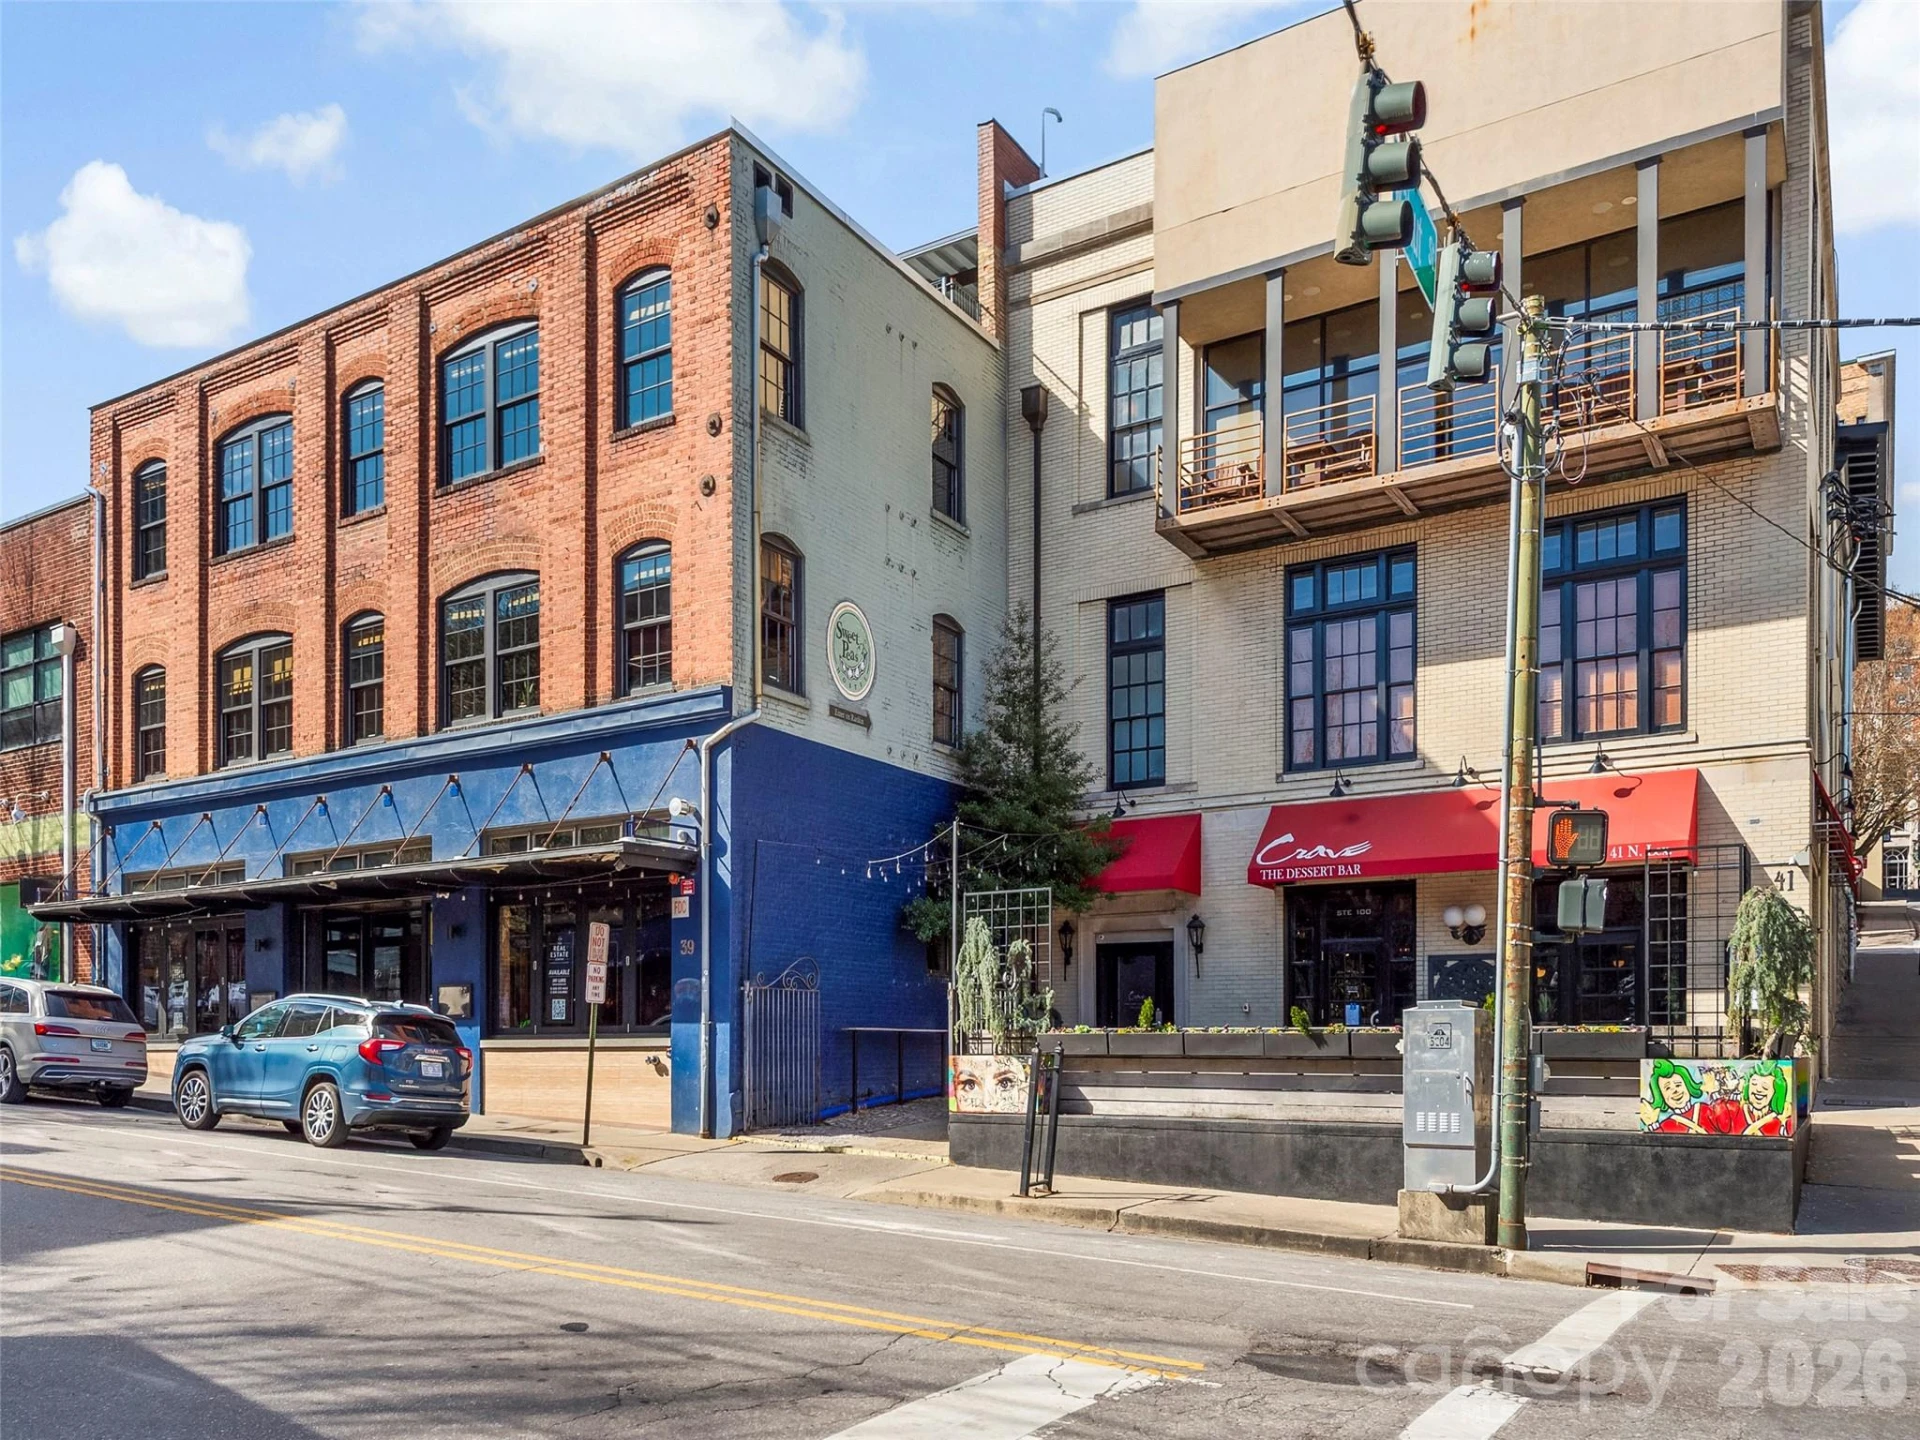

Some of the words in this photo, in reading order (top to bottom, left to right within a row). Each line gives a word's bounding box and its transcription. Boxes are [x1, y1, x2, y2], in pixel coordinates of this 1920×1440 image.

[836, 621, 860, 645] Sweet
[842, 640, 859, 662] Peas
[1256, 833, 1372, 865] Crave
[1609, 845, 1623, 859] 41
[1627, 845, 1642, 858] N.
[1260, 869, 1284, 880] THE
[1286, 865, 1336, 880] DESSERT
[1338, 863, 1362, 876] BAR
[1774, 870, 1795, 891] 41
[674, 900, 687, 915] FDC
[595, 926, 605, 937] DO
[592, 936, 605, 947] NOT
[680, 939, 695, 955] 39
[548, 968, 571, 976] AVAILABLE
[593, 967, 601, 975] NO
[588, 975, 605, 983] PARKING
